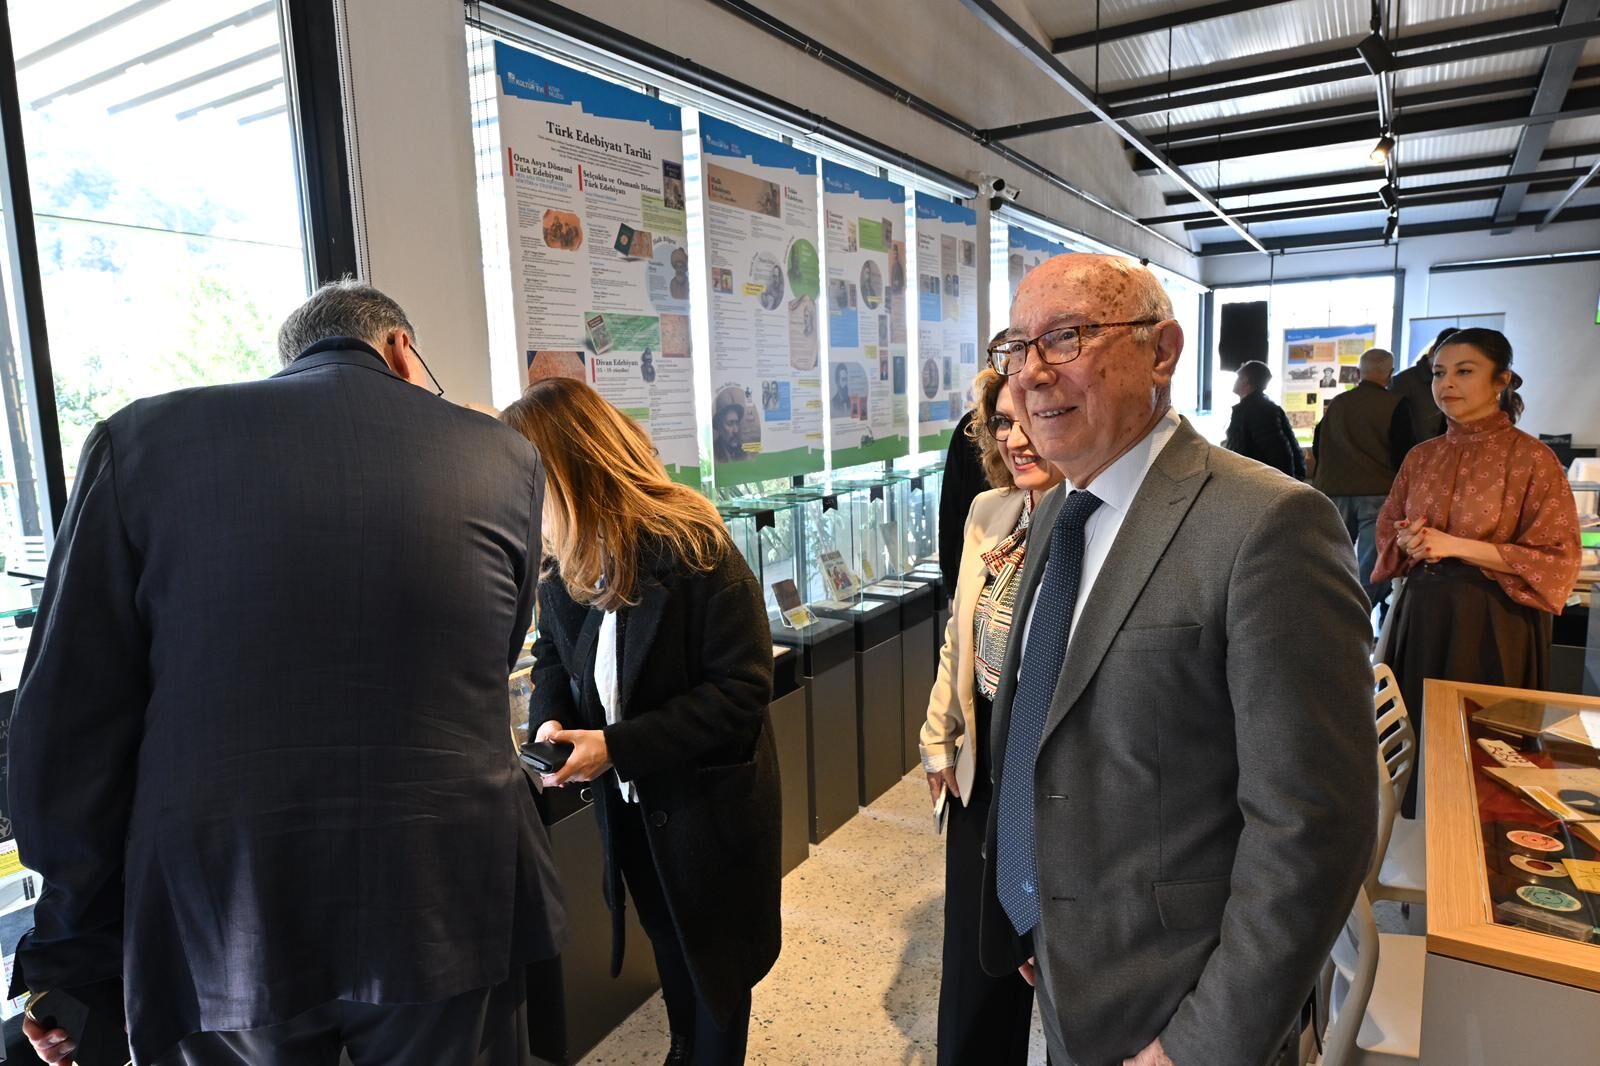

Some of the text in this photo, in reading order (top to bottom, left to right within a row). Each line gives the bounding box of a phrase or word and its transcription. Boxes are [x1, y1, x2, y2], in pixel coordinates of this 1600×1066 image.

[545, 121, 574, 140] Türk
[576, 129, 622, 152] Edebiyatı
[624, 143, 652, 161] Tarihi
[513, 153, 573, 174] Orta Asya Dönemi
[514, 163, 564, 181] Türk Edebiyatı
[584, 179, 599, 189] Türk
[599, 183, 626, 196] Edebiyatı
